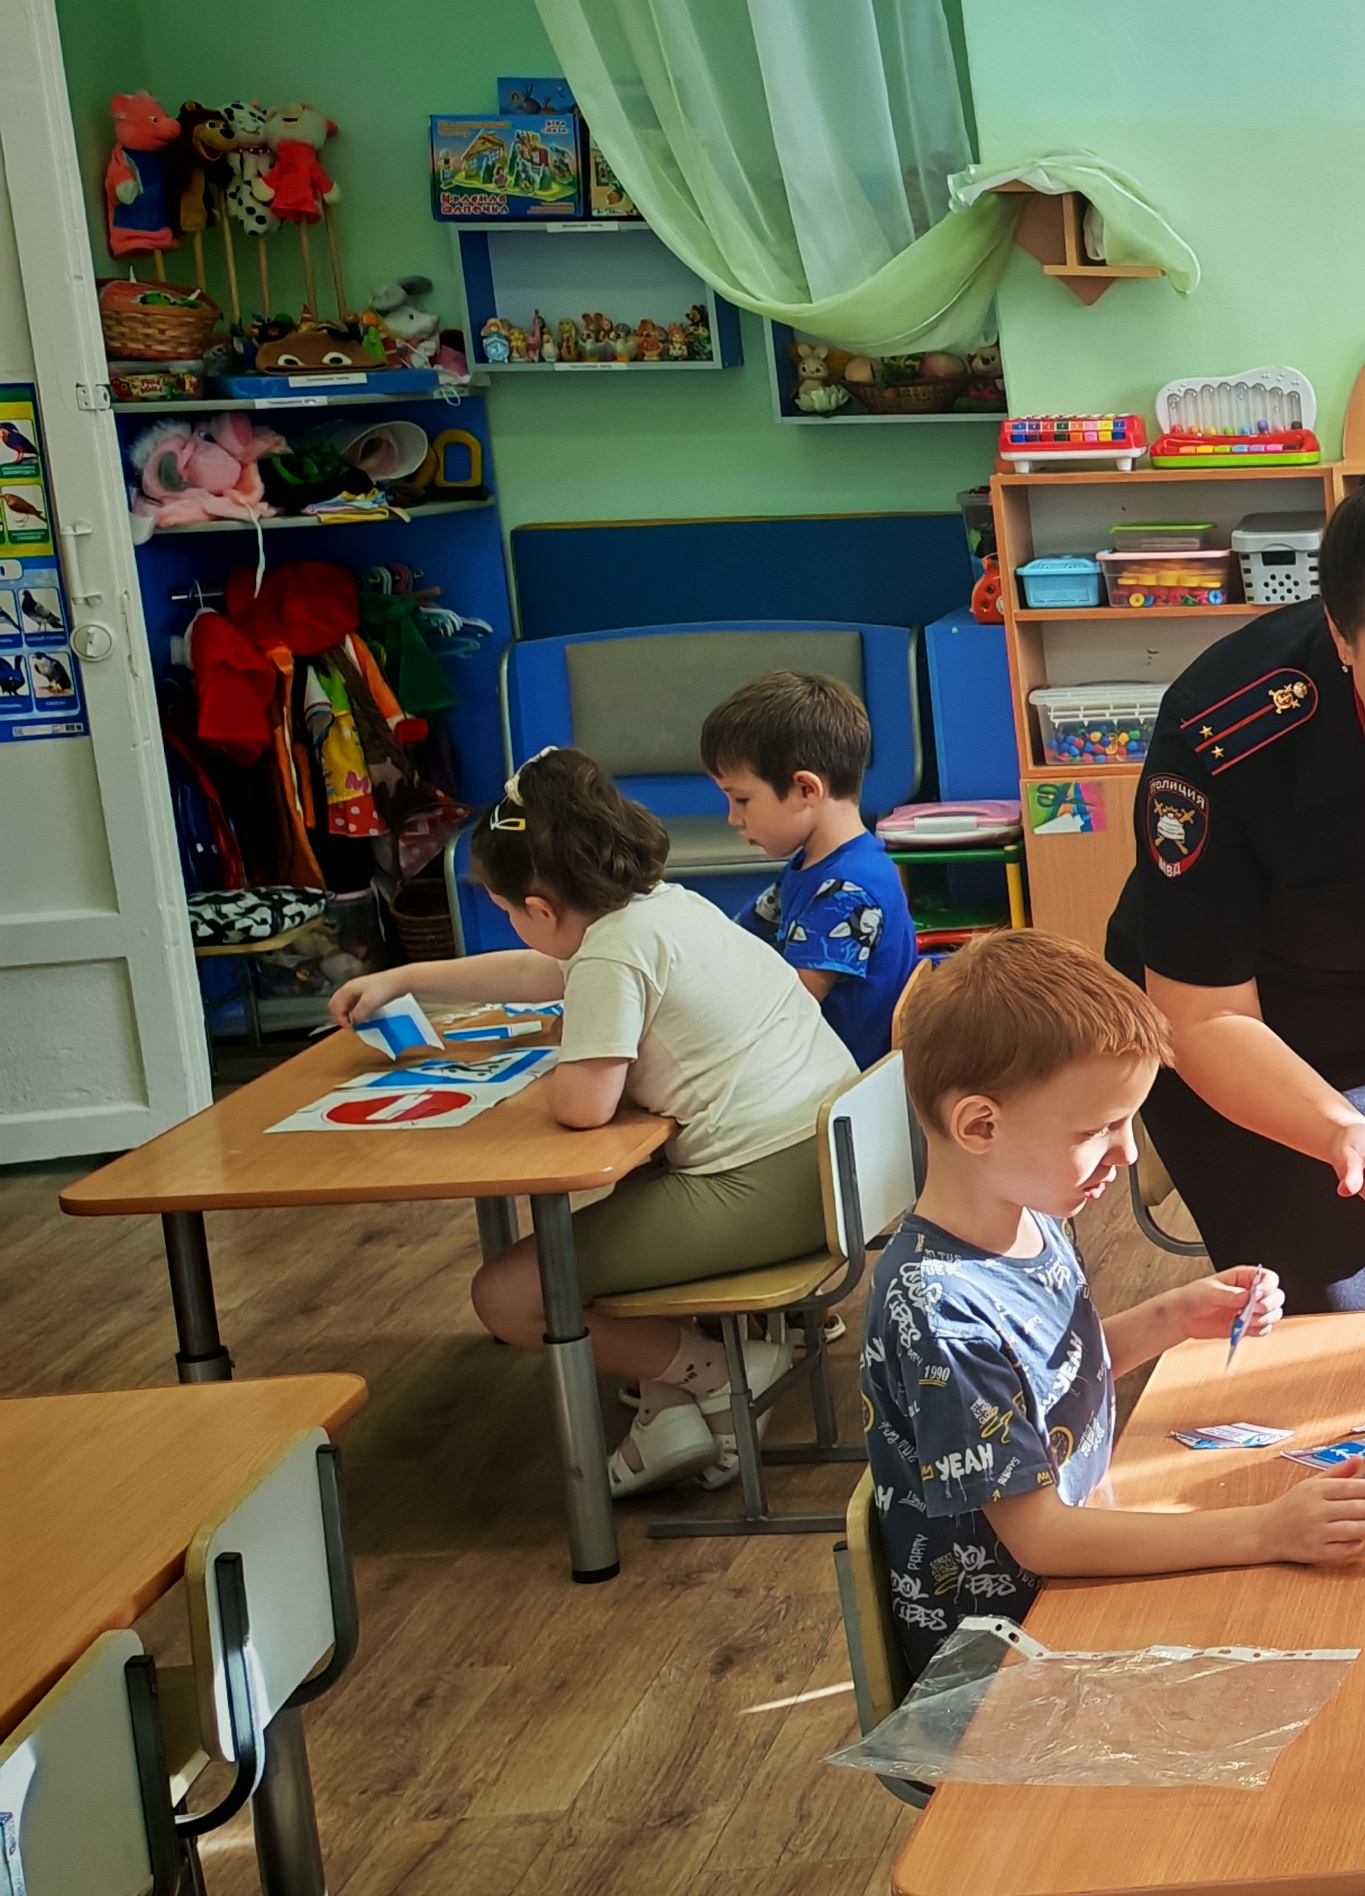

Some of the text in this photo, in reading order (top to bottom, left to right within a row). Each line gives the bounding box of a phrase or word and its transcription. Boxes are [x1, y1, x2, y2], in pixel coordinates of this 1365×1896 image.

[1150, 779, 1205, 810] ПОЛИЦИЯ
[1158, 856, 1181, 877] МВД
[924, 1364, 951, 1382] 1990
[935, 1442, 994, 1481] YEAH
[907, 1533, 930, 1571] PARTY
